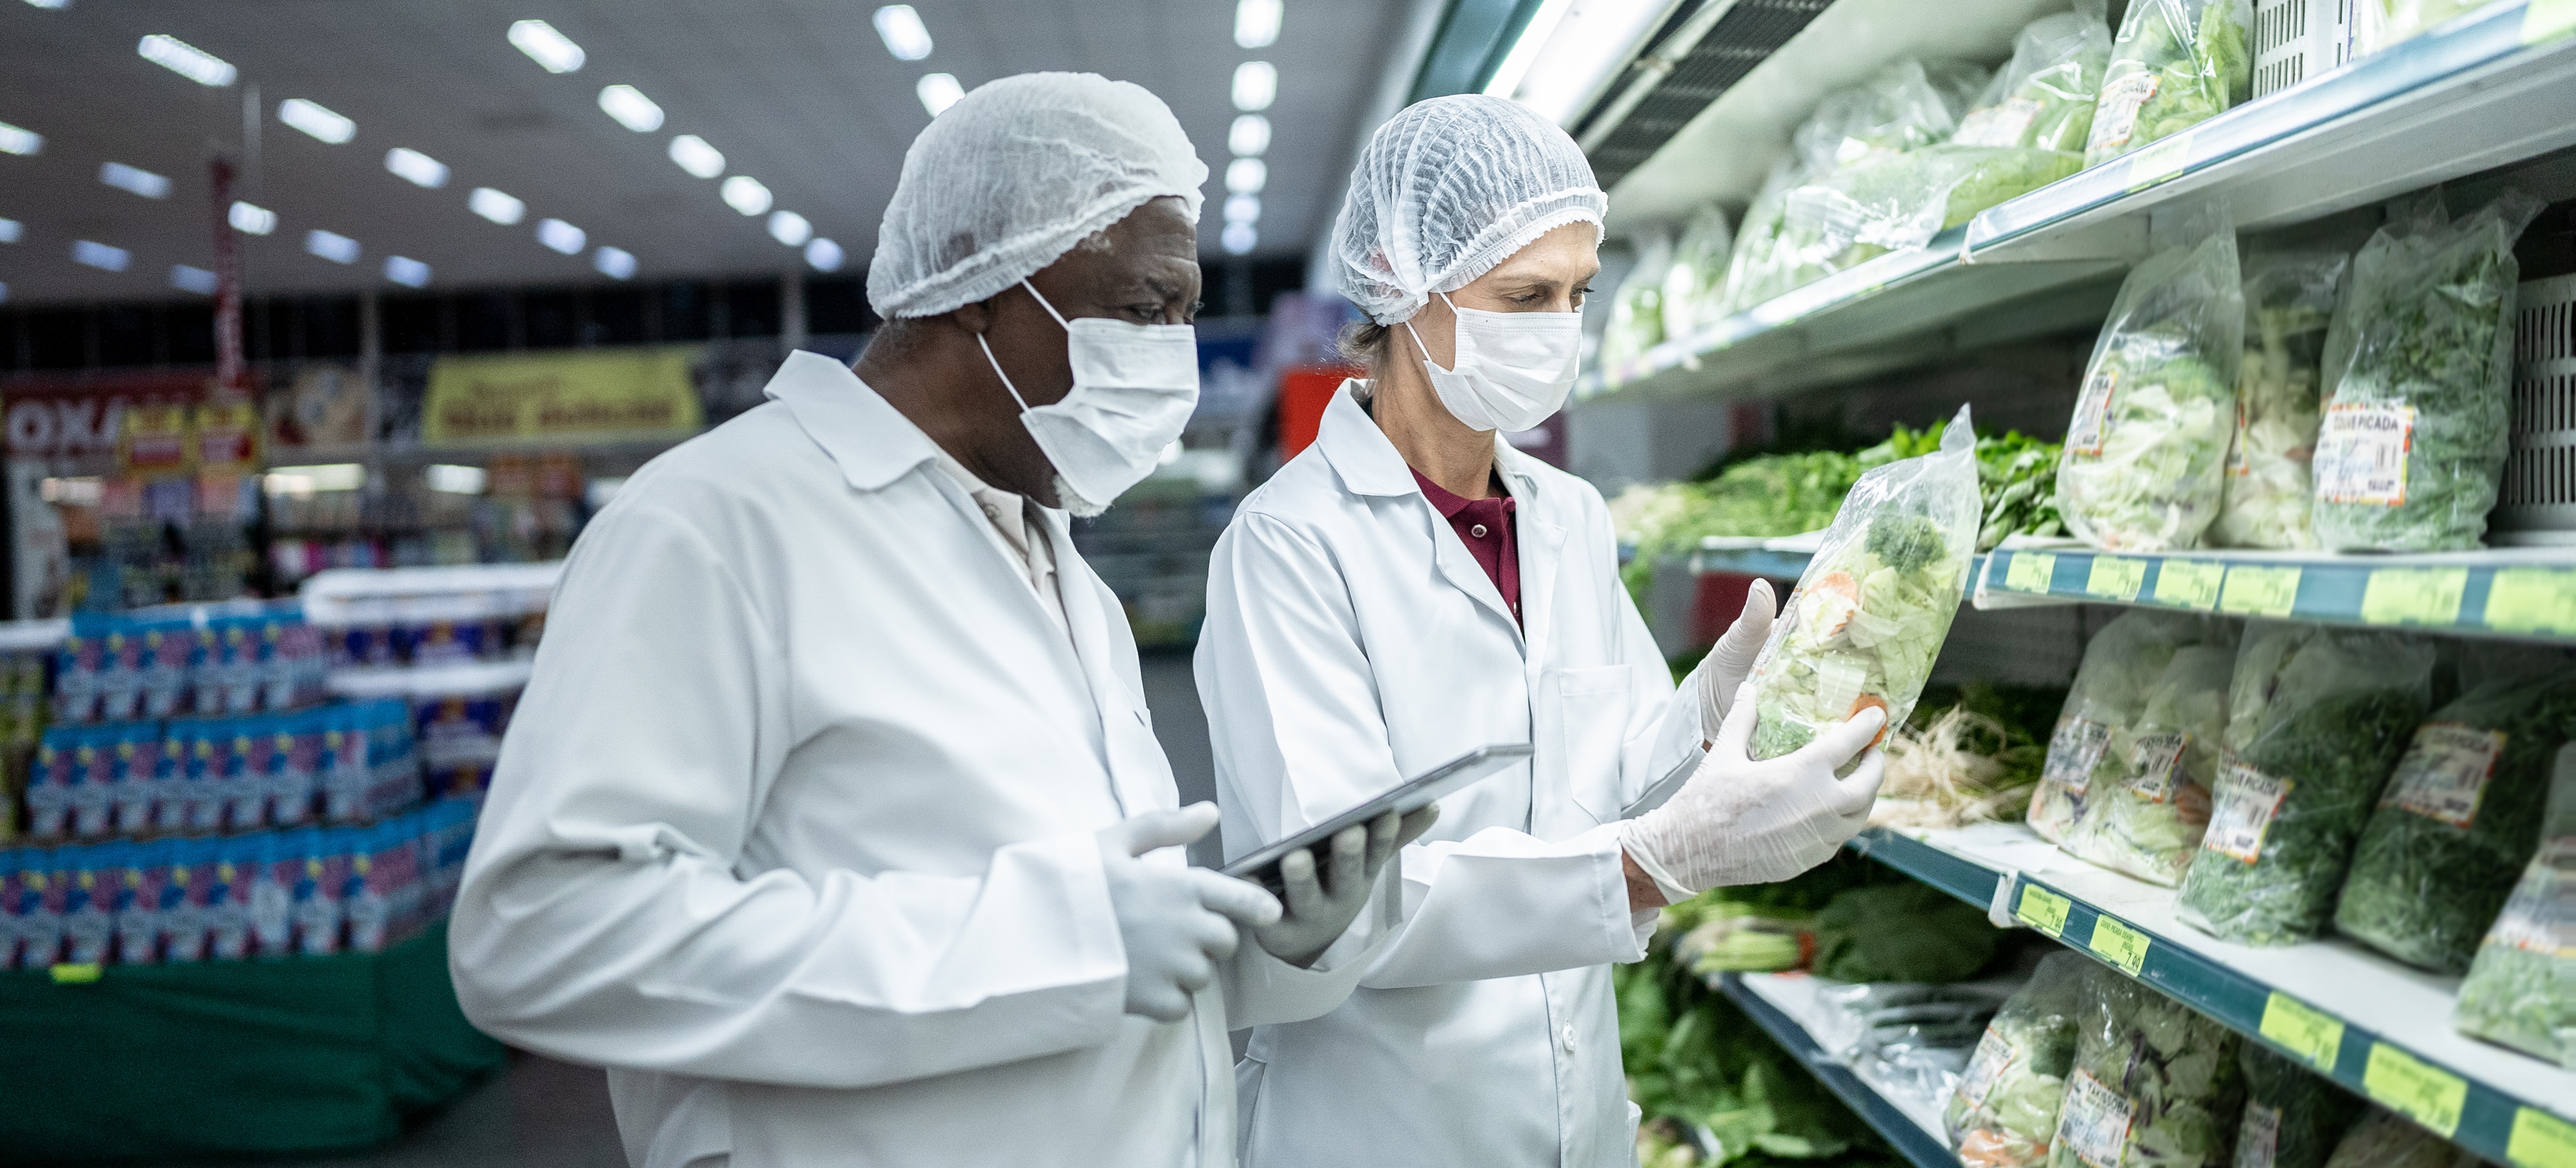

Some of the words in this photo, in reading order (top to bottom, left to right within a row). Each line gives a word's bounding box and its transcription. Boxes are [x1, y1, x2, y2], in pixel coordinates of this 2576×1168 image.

[2357, 415, 2398, 431] PICADA
[2100, 919, 2111, 931] COUVE
[2110, 923, 2122, 937] PICADA
[2087, 1081, 2129, 1116] YAKISSOBA
